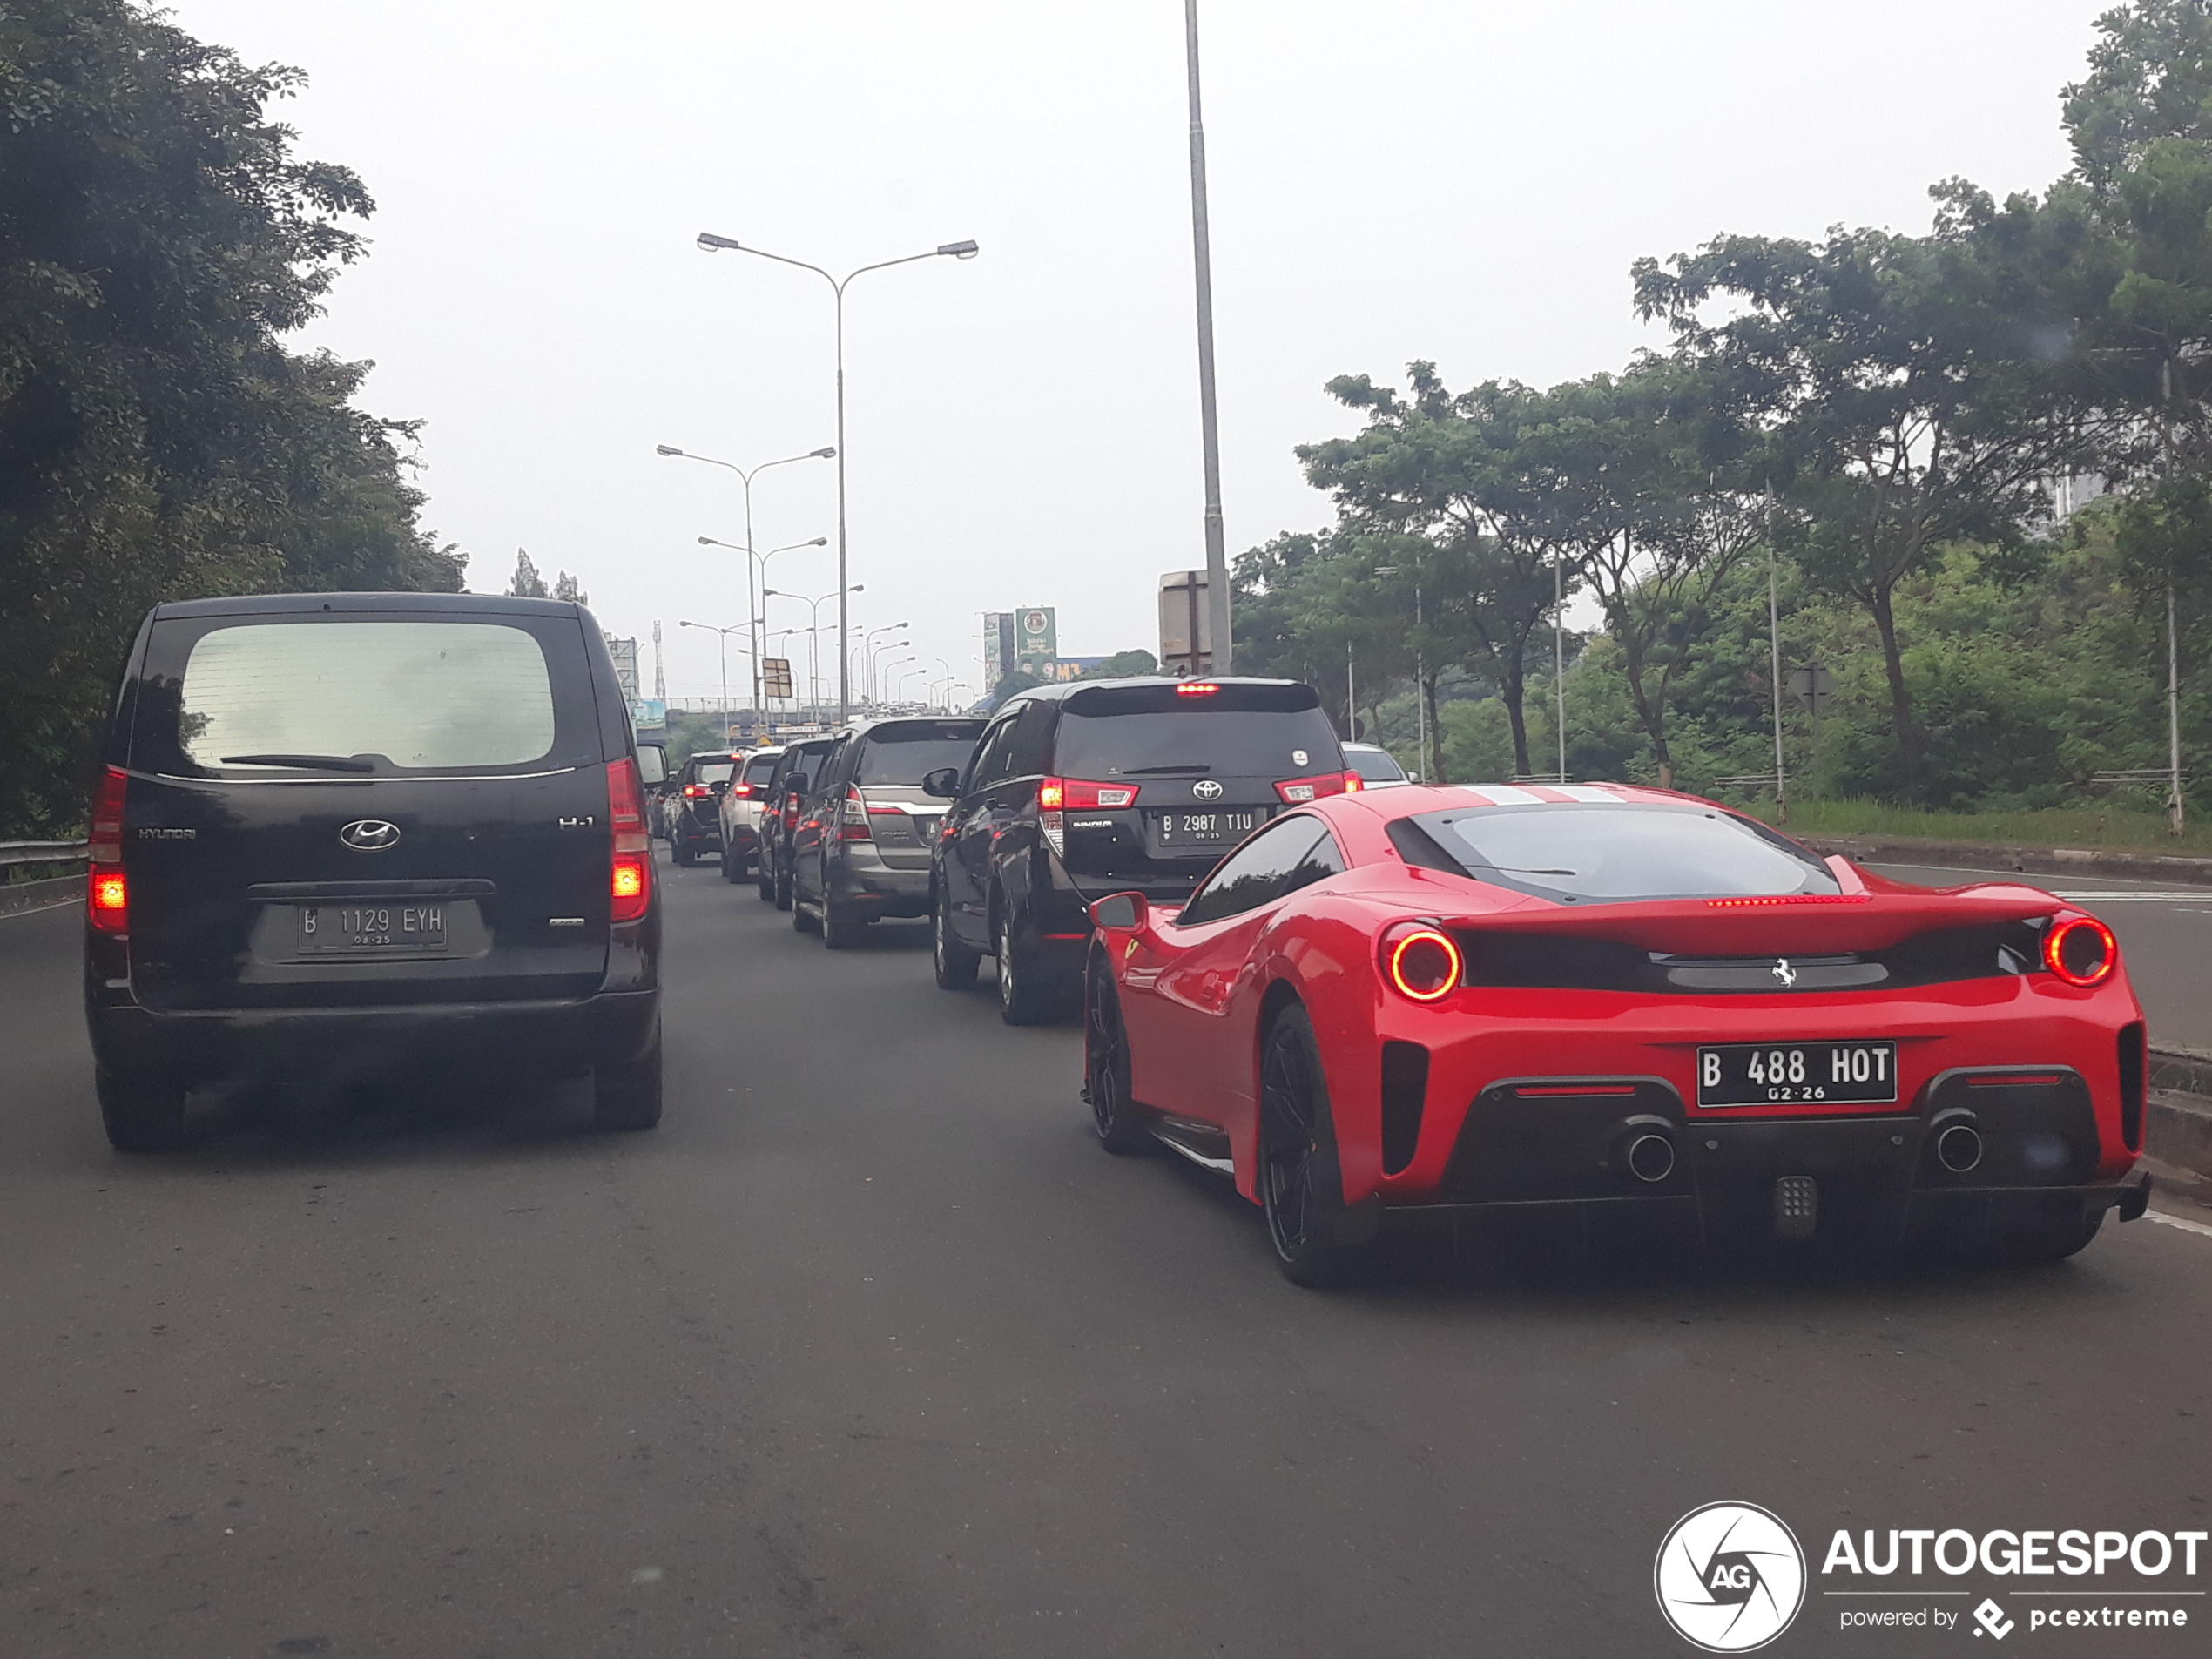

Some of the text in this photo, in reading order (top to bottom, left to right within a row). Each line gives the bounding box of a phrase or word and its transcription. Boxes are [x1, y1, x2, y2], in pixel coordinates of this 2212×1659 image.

[558, 816, 594, 829] H-1
[1163, 813, 1252, 832] B 2987 TIU
[138, 828, 196, 840] HYUNDAI
[305, 908, 442, 934] B 1129 EYH
[1703, 1047, 1890, 1088] B 488 HOT
